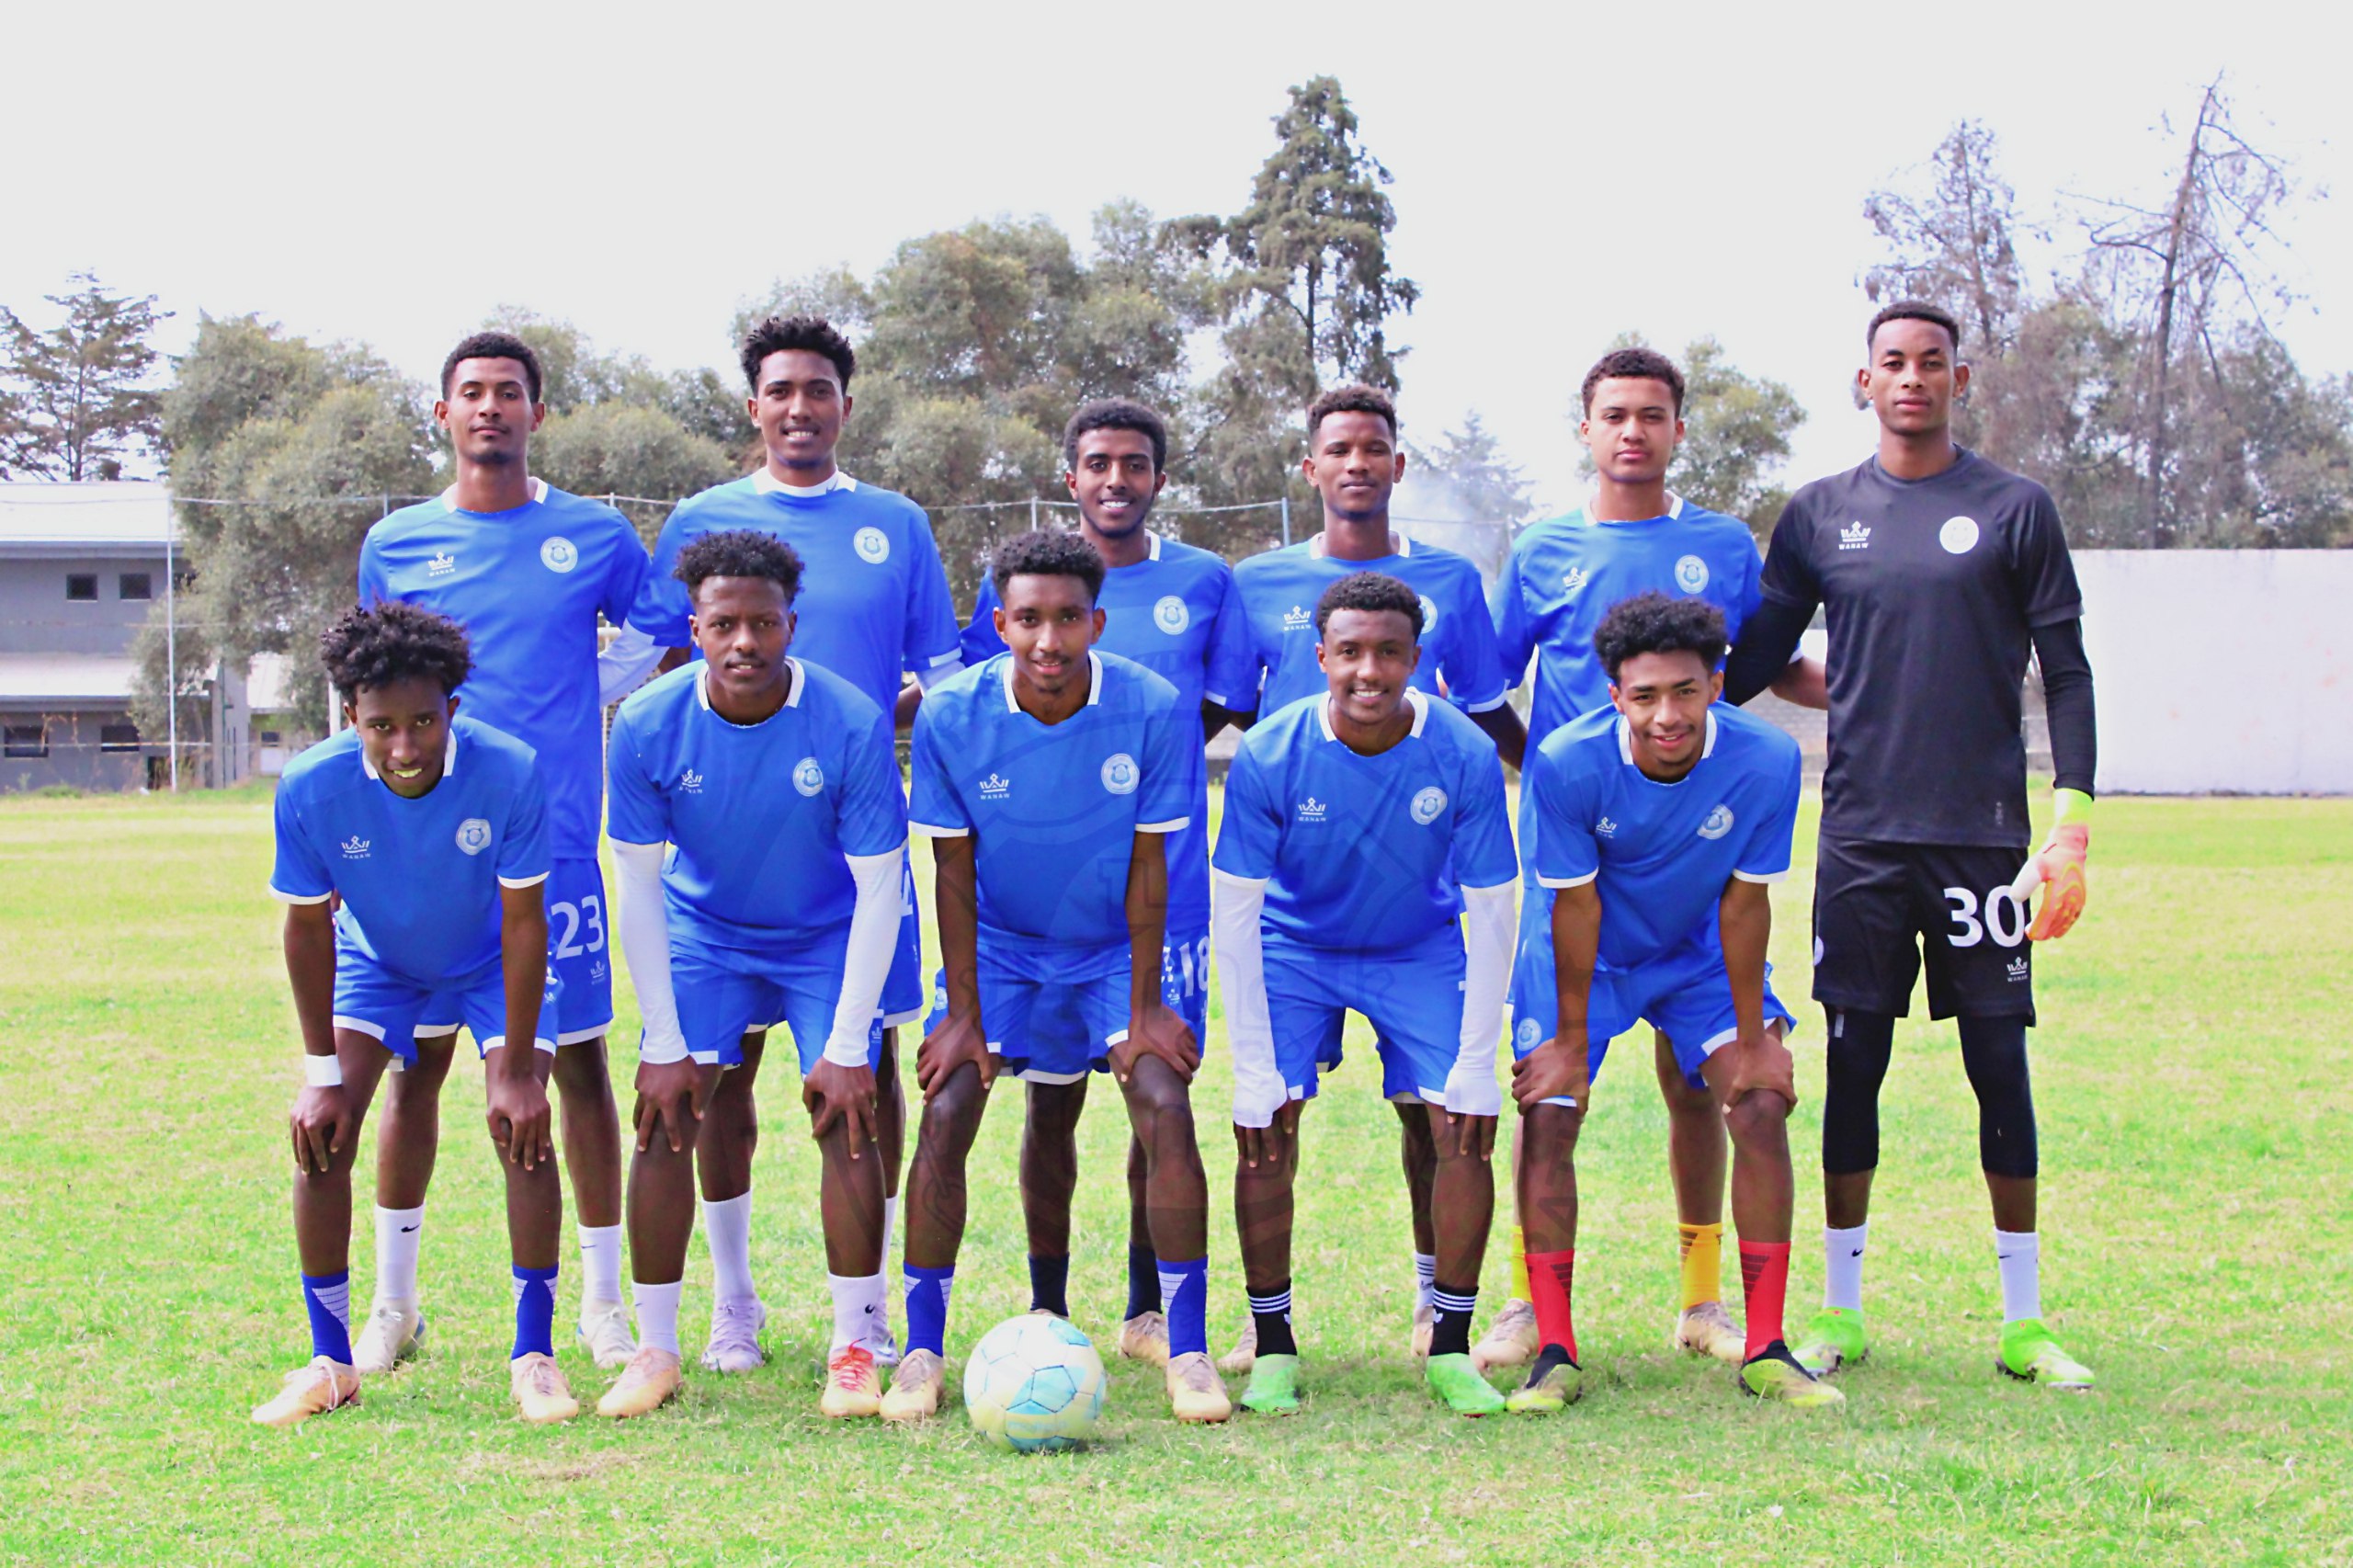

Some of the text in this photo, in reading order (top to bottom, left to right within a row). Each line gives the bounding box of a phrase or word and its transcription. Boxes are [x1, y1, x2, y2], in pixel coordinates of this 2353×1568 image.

[1839, 542, 1869, 551] WANAW
[551, 894, 605, 960] 23
[1944, 885, 2025, 948] 30
[1178, 936, 1210, 998] 18
